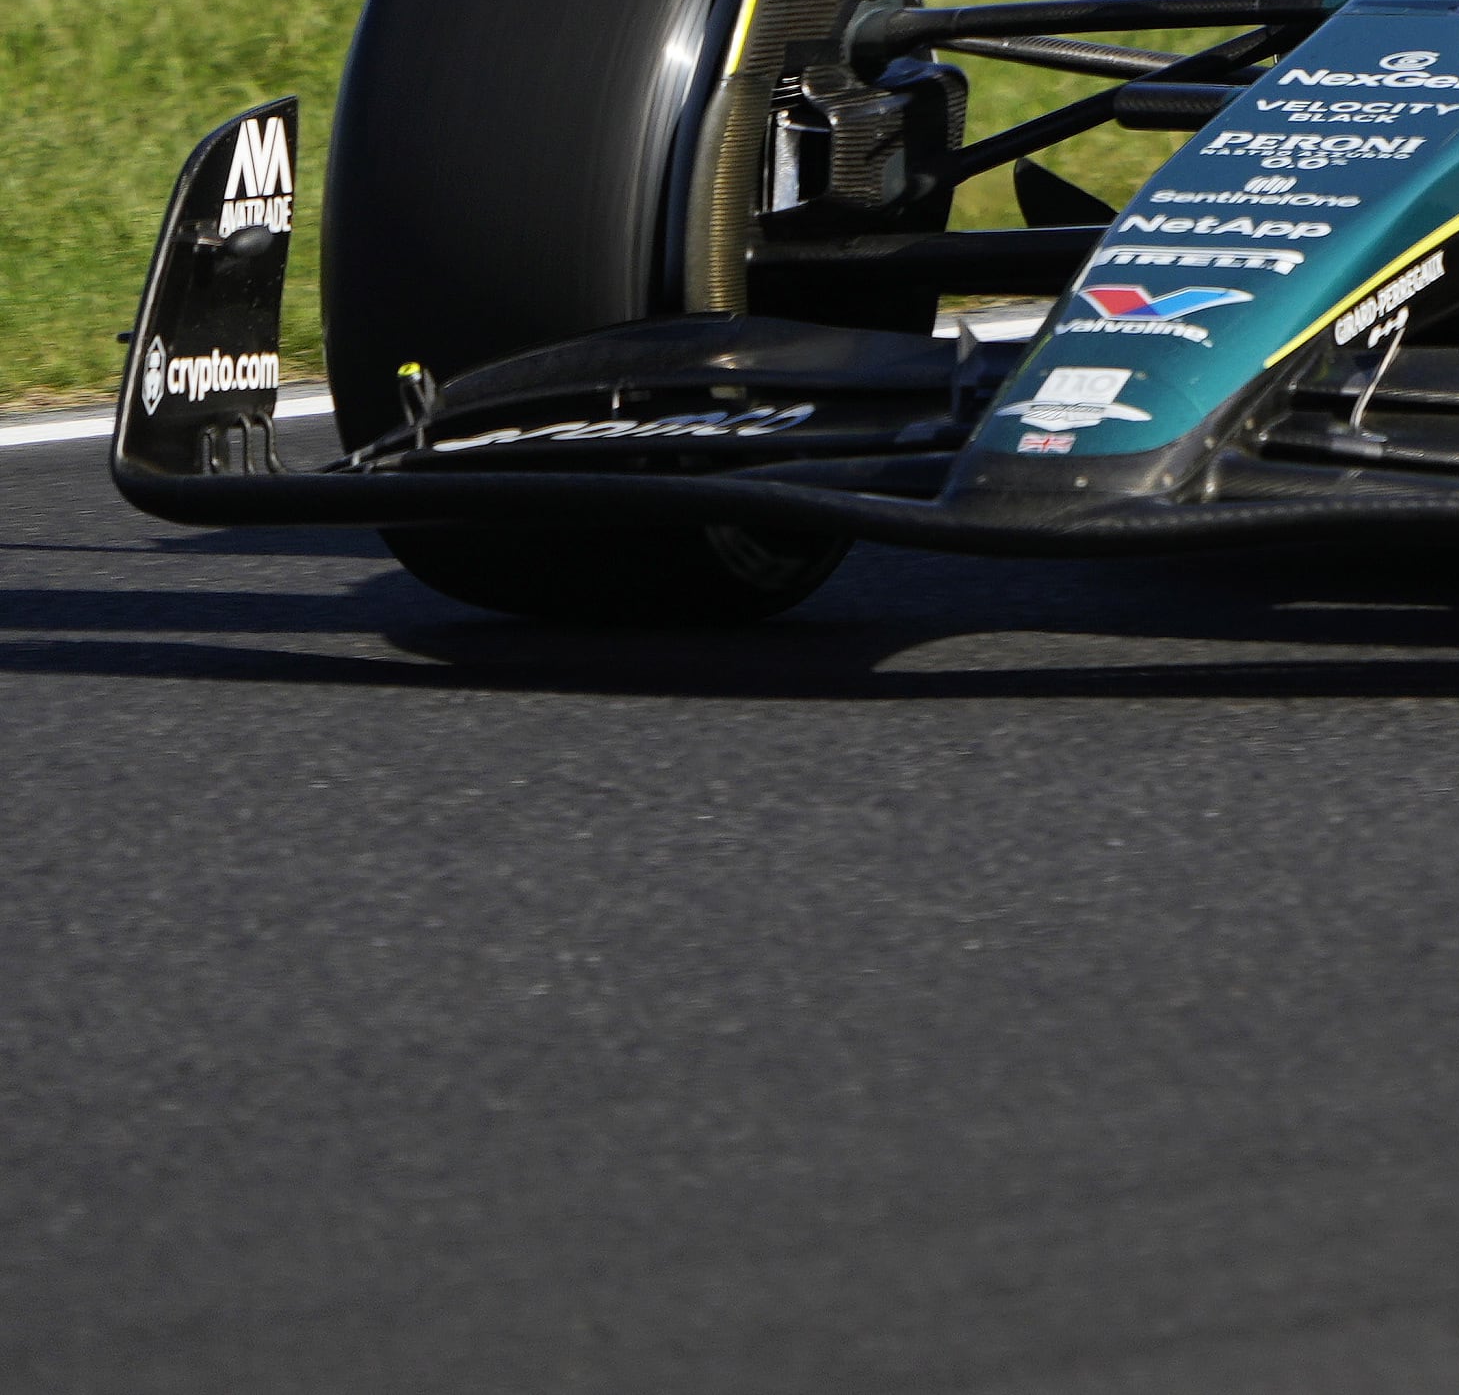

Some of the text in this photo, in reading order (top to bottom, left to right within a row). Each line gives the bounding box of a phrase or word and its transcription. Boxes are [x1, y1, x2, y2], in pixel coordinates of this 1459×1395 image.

[1288, 112, 1401, 124] BLACK
[1207, 130, 1428, 154] PERONI
[1149, 189, 1361, 208] SentinelOne
[218, 195, 293, 239] AVATRADE
[1118, 214, 1332, 240] NetApp
[167, 348, 280, 402] crypto.com
